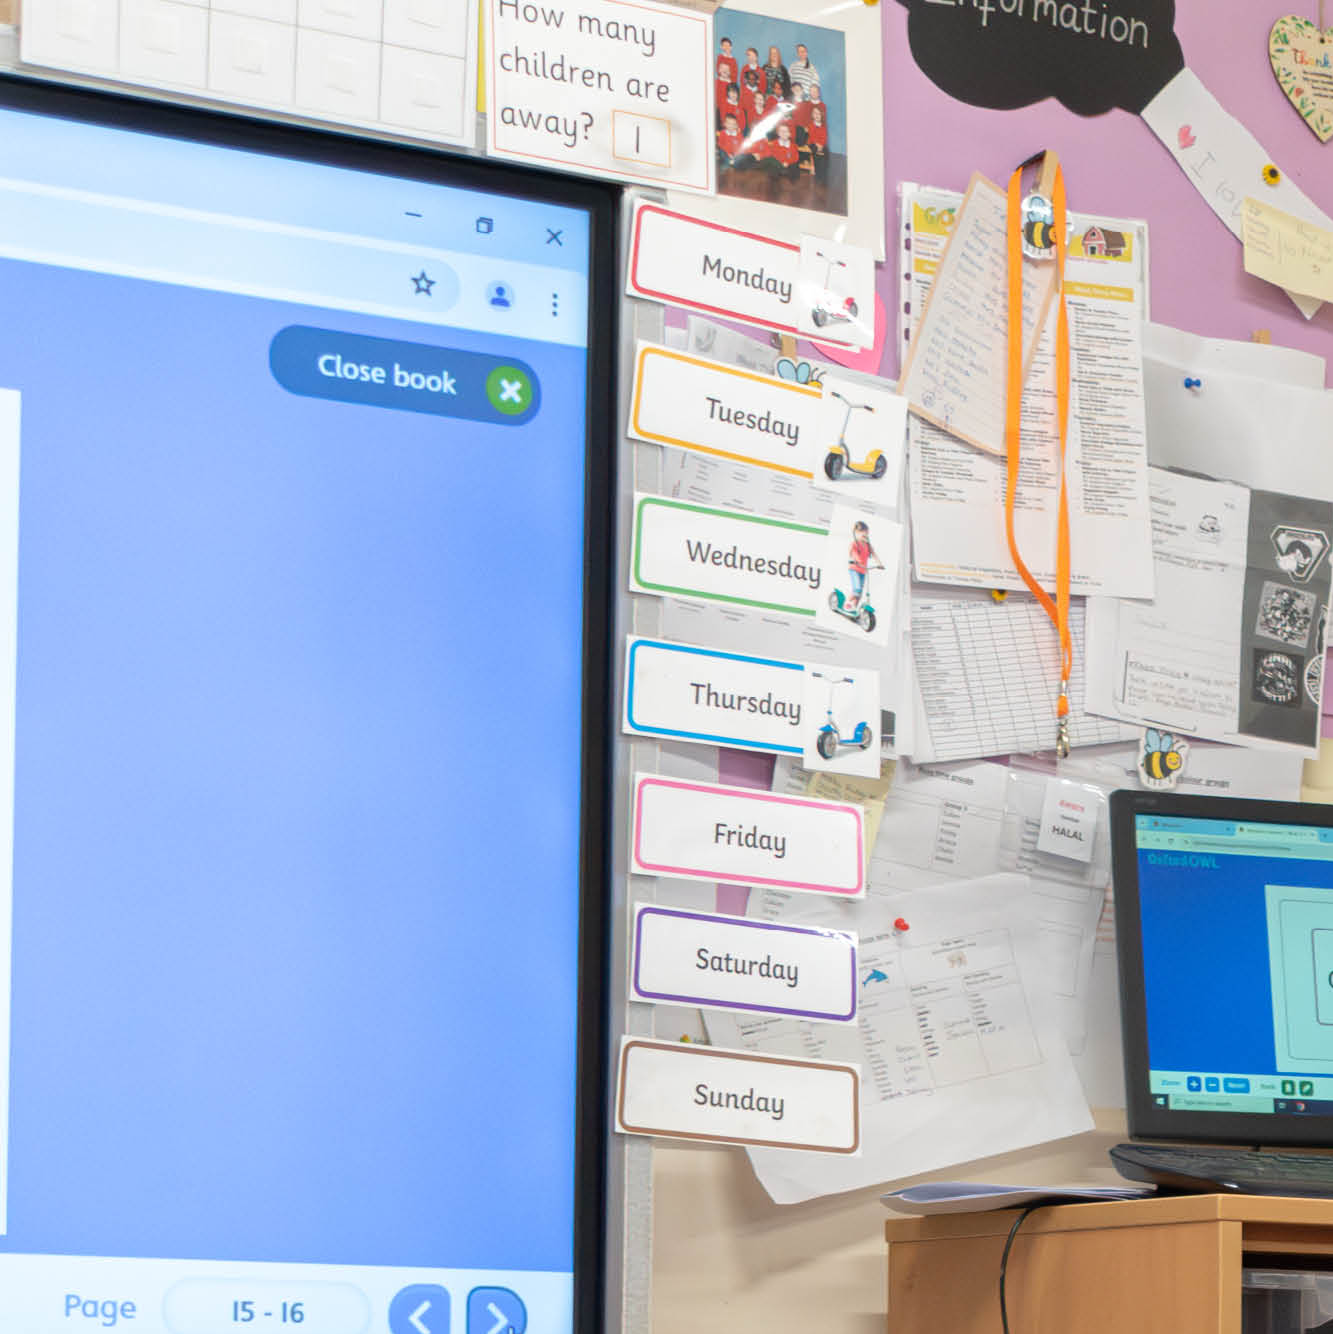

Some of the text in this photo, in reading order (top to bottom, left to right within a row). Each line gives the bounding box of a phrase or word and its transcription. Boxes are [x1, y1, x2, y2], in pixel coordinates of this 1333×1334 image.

[499, 0, 655, 57] How many
[925, 0, 1148, 48] formation
[499, 46, 670, 102] children are
[501, 107, 594, 148] away?
[702, 254, 793, 305] Monday
[318, 353, 457, 396] Close book
[706, 396, 800, 447] Tuesday
[686, 539, 822, 590] Wednesday
[690, 682, 801, 726] Thursday
[714, 822, 787, 859] Friday
[1052, 825, 1084, 842] HALAL
[696, 948, 799, 987] Saturday
[694, 1083, 785, 1121] Sunday
[64, 1294, 137, 1328] Page
[233, 1300, 255, 1322] 15
[281, 1302, 305, 1323] 16
